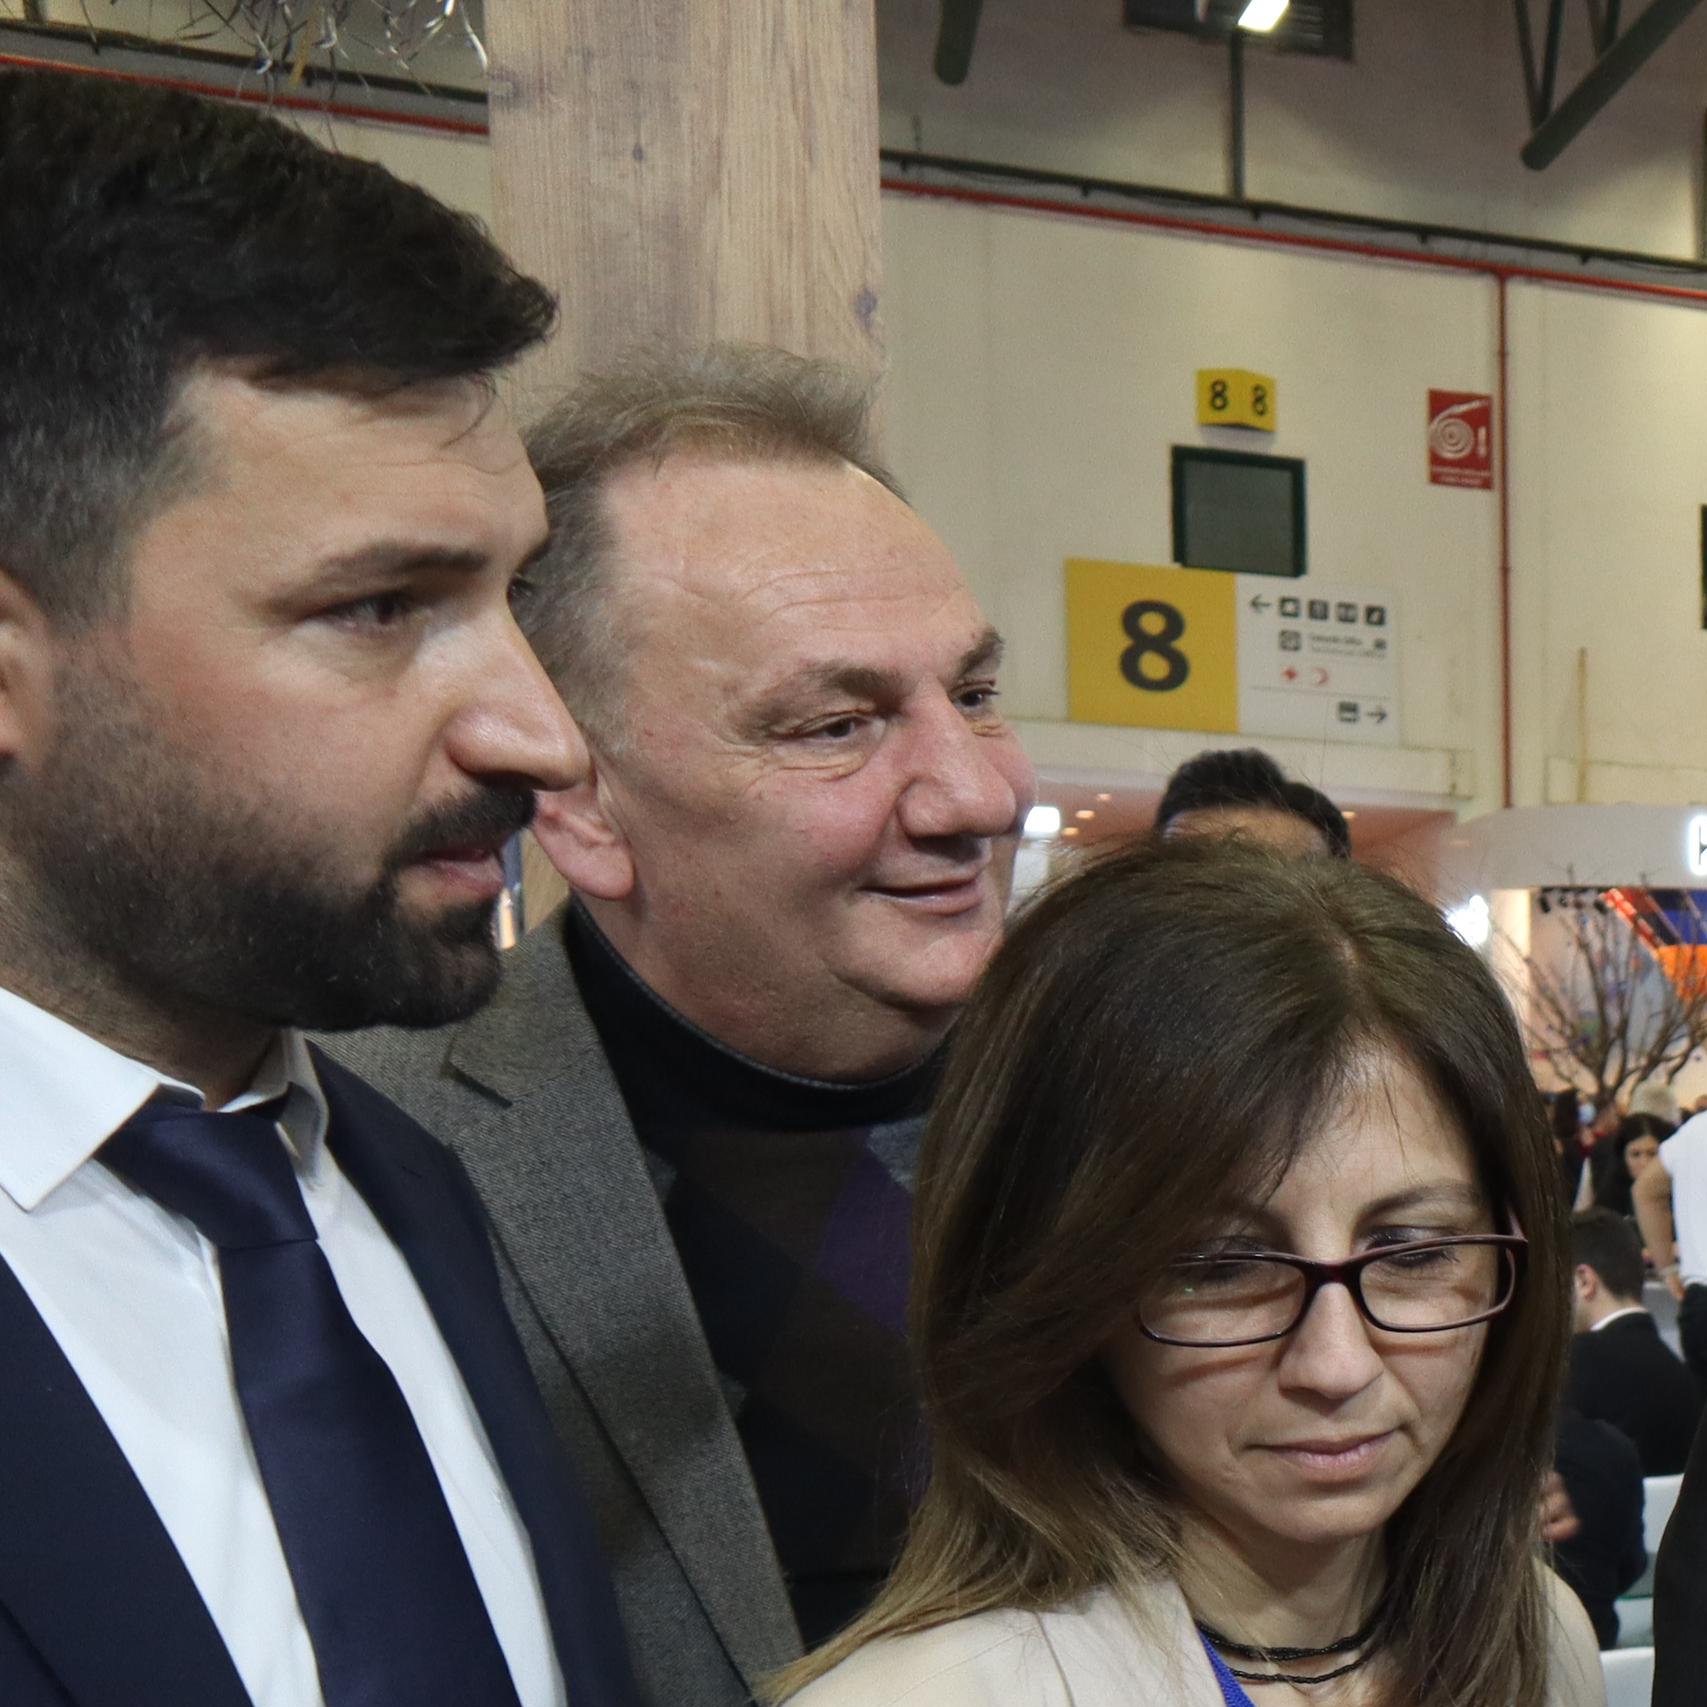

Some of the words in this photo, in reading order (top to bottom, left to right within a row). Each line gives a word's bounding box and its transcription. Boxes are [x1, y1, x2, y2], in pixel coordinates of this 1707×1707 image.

[1209, 379, 1230, 411] 8
[1251, 384, 1268, 417] 8
[1118, 599, 1191, 693] 8
